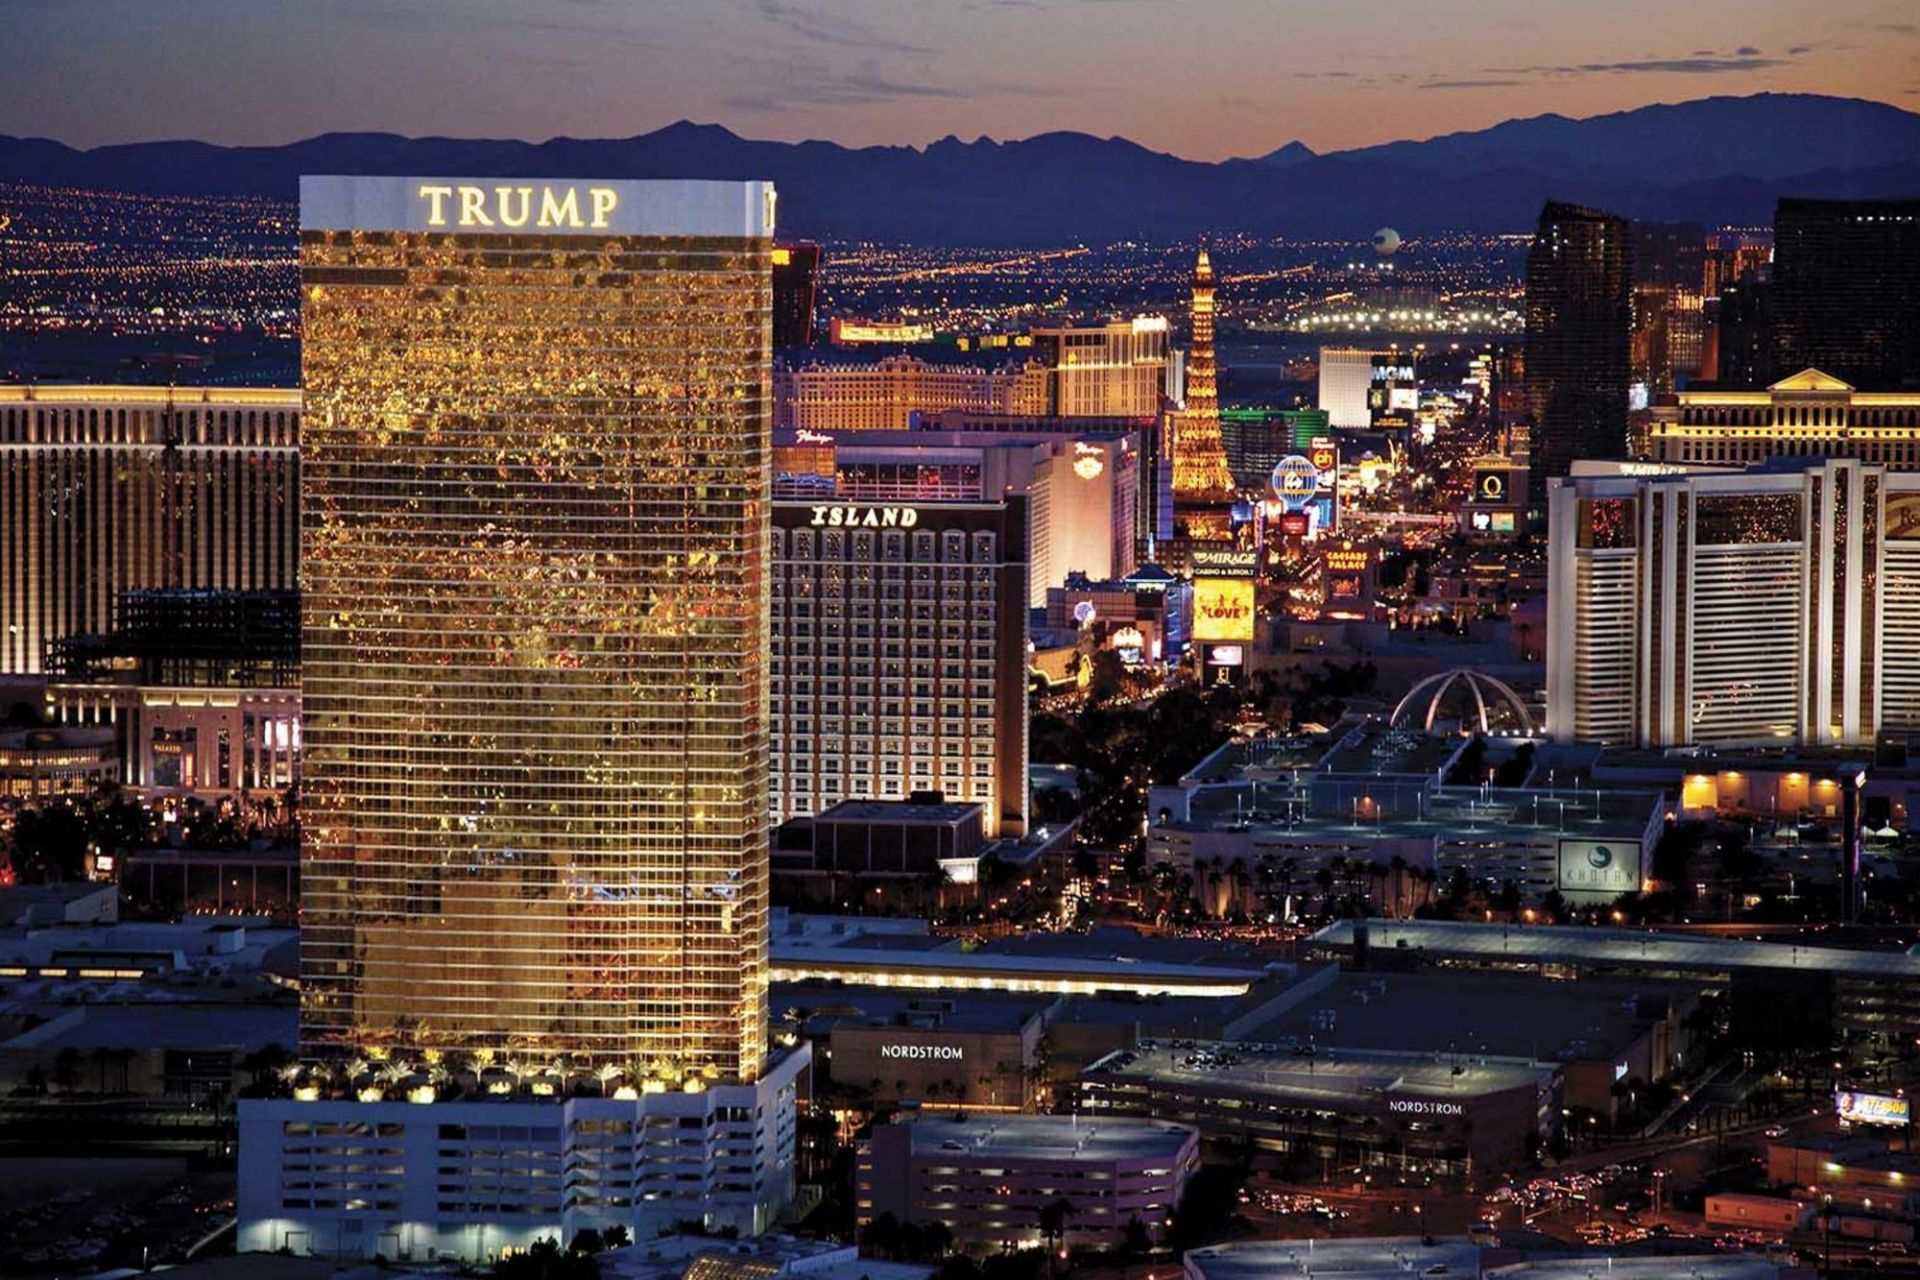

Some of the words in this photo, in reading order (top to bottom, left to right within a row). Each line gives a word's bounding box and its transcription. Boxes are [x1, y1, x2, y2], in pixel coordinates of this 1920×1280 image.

[419, 185, 618, 228] TRUMP
[810, 505, 918, 527] ISLAND
[1207, 607, 1241, 619] LOVE
[881, 1044, 963, 1060] NORDSTROM
[1389, 1100, 1462, 1115] NORDSTROM
